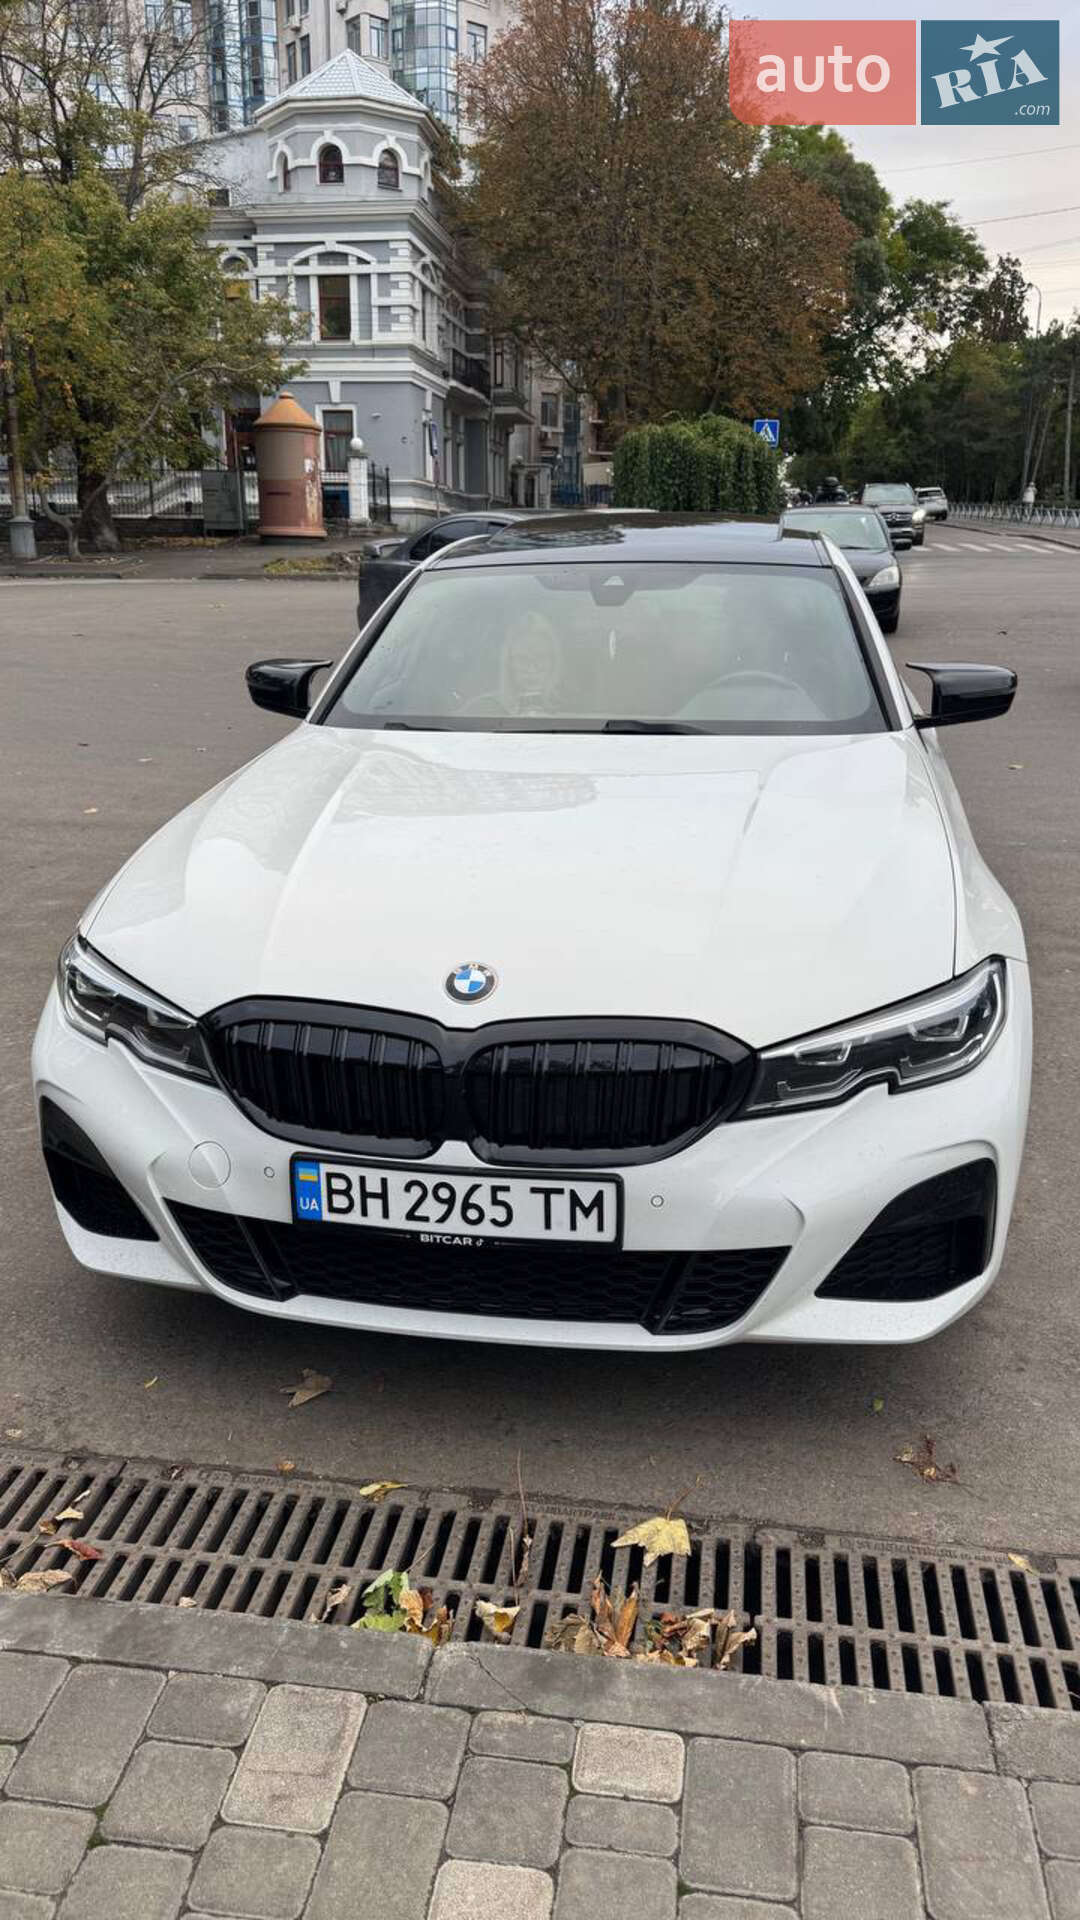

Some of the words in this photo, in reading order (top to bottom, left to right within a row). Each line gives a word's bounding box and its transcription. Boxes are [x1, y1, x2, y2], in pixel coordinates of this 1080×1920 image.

[299, 1197, 320, 1211] UA
[325, 1171, 390, 1220] BH
[403, 1179, 514, 1228] 2965
[529, 1187, 604, 1233] TM
[419, 1233, 473, 1246] BITCAR
